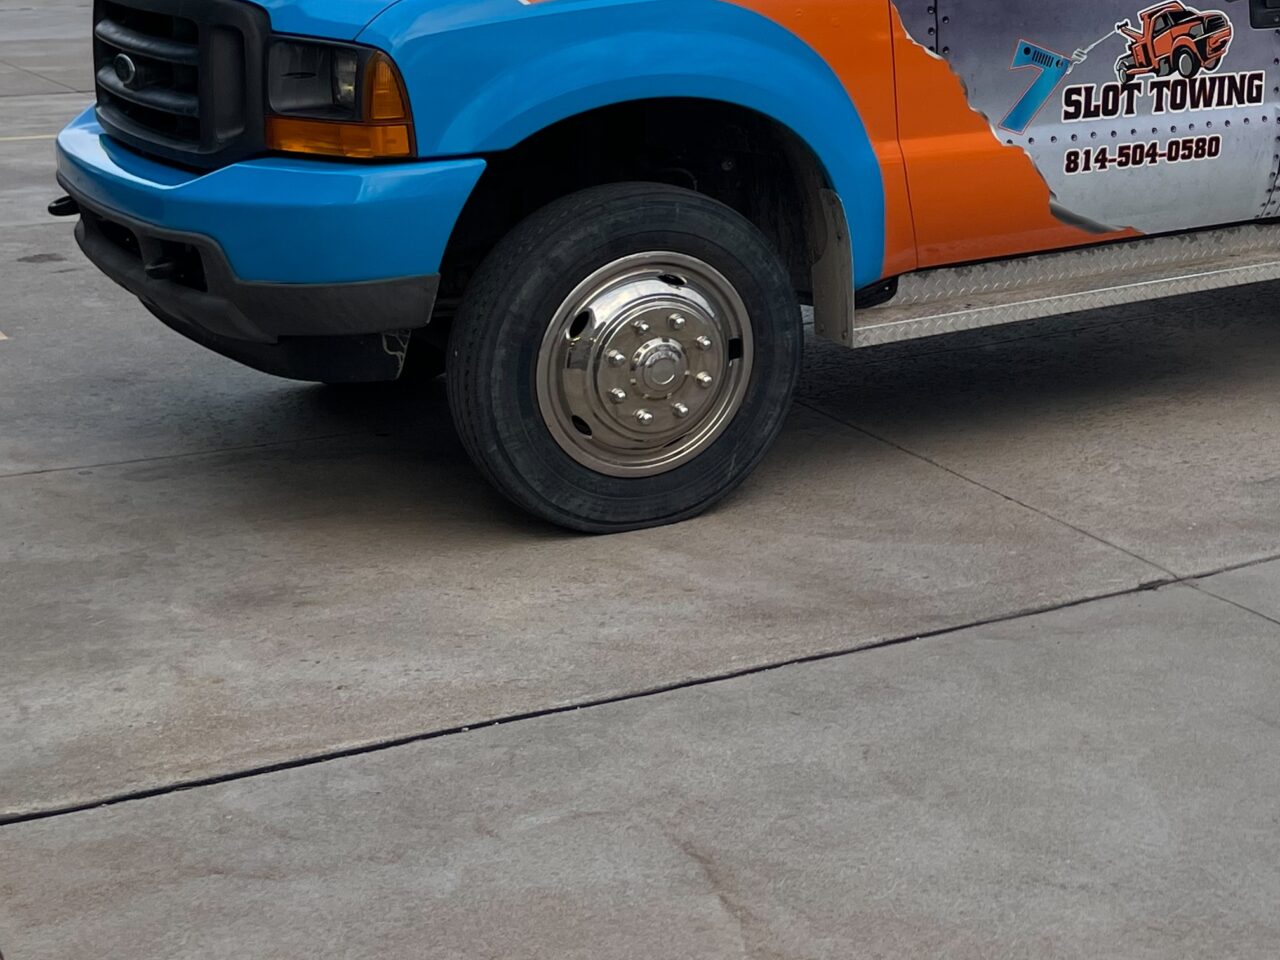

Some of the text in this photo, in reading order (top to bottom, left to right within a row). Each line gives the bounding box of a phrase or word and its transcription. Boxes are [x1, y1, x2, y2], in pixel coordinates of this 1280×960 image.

[998, 38, 1266, 135] 7 SLOT TOWING
[1064, 135, 1223, 175] 814-504-0580
